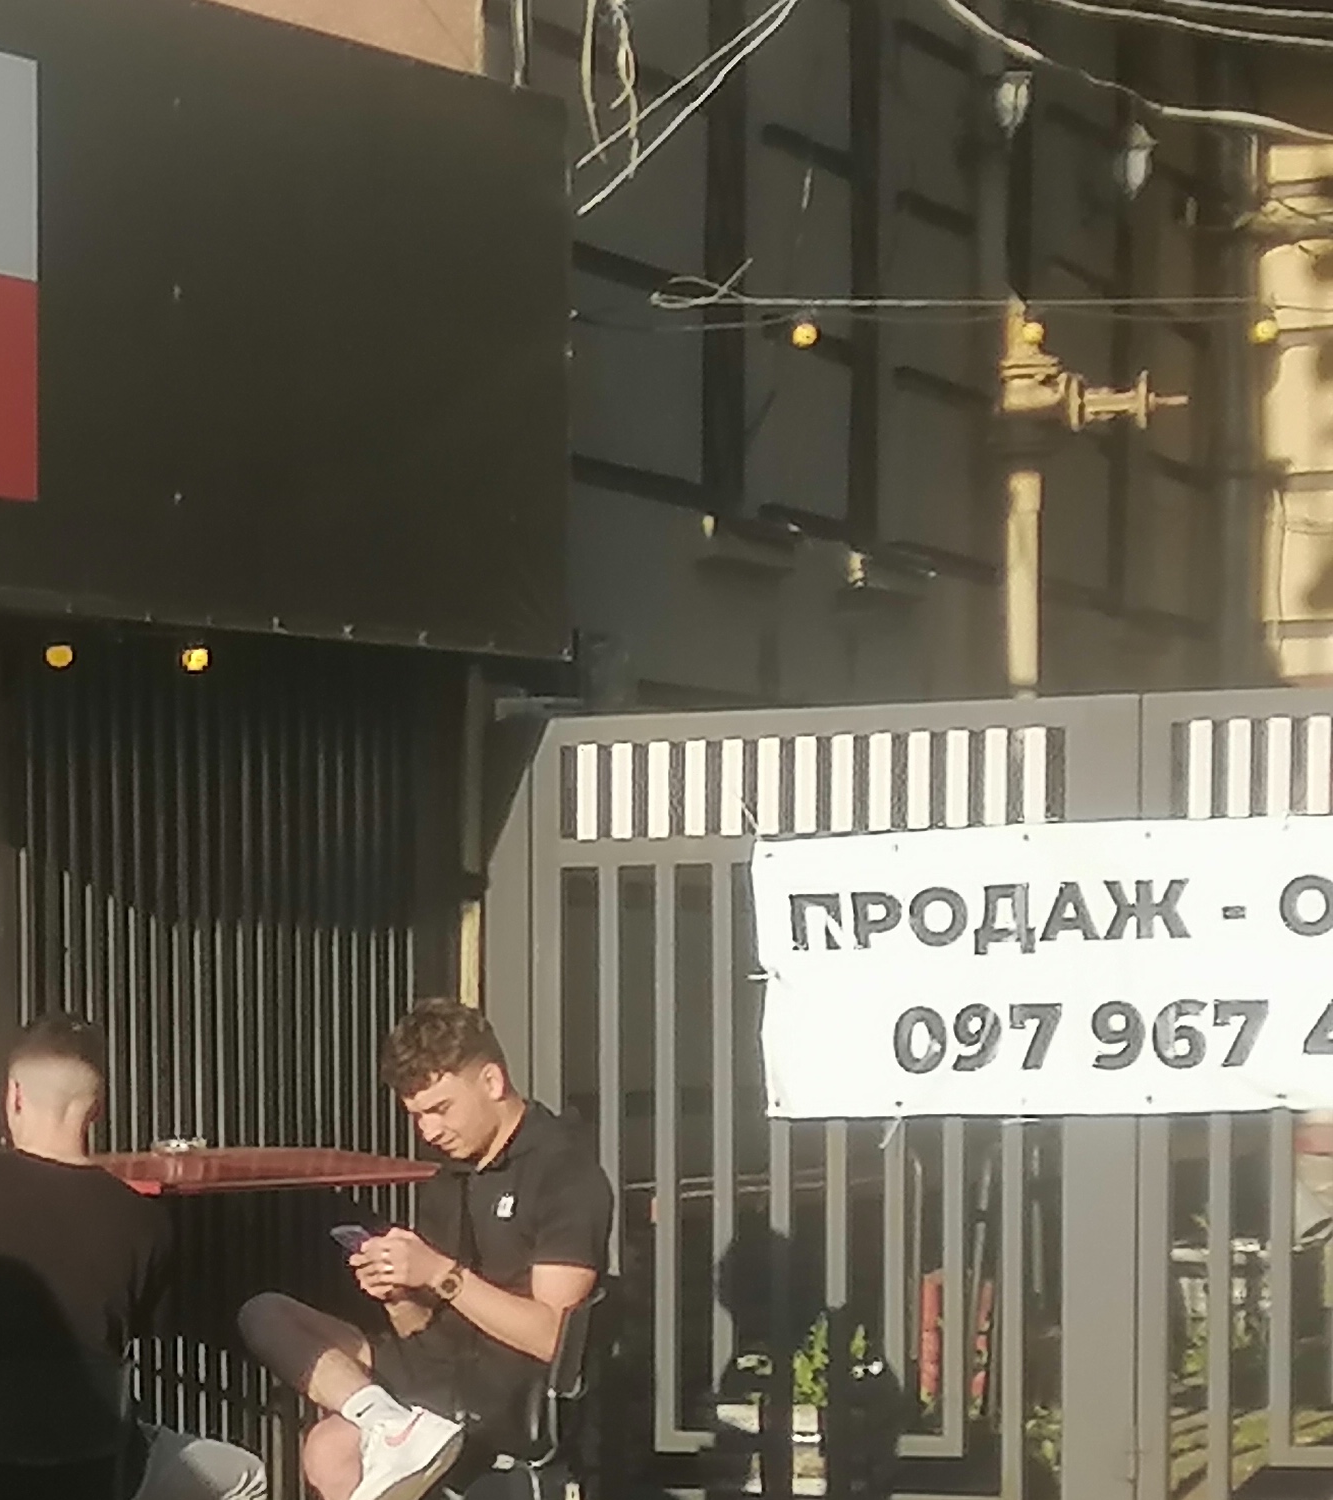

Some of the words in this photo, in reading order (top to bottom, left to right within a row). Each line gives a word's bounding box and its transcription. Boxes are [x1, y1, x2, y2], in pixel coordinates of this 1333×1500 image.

[789, 878, 1191, 955] ПРОДАЖ
[893, 1001, 1062, 1074] 097
[1091, 999, 1269, 1071] 967
